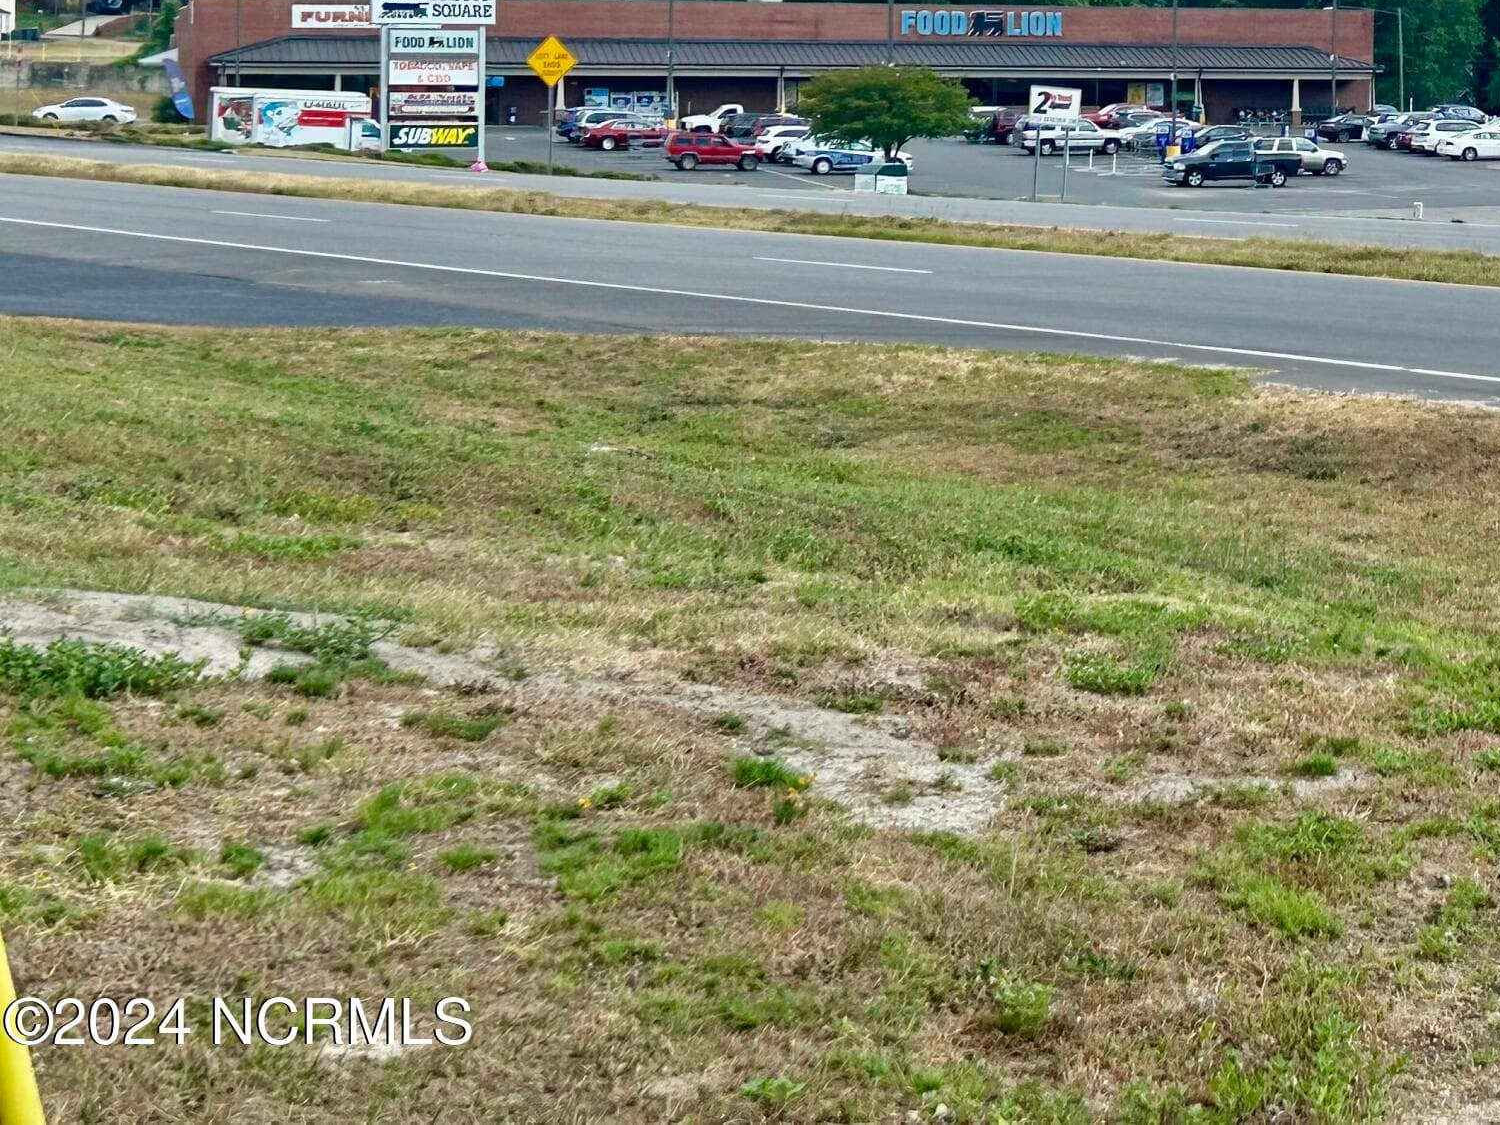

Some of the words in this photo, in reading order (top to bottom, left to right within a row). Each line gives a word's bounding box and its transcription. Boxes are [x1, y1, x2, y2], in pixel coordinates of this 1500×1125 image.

[432, 3, 492, 19] SQUARE
[901, 10, 967, 36] FOOD
[1006, 11, 1063, 37] LION
[394, 36, 425, 48] FOOD
[445, 37, 474, 48] LION
[427, 74, 451, 83] CBD
[392, 127, 476, 145] SUBWAY
